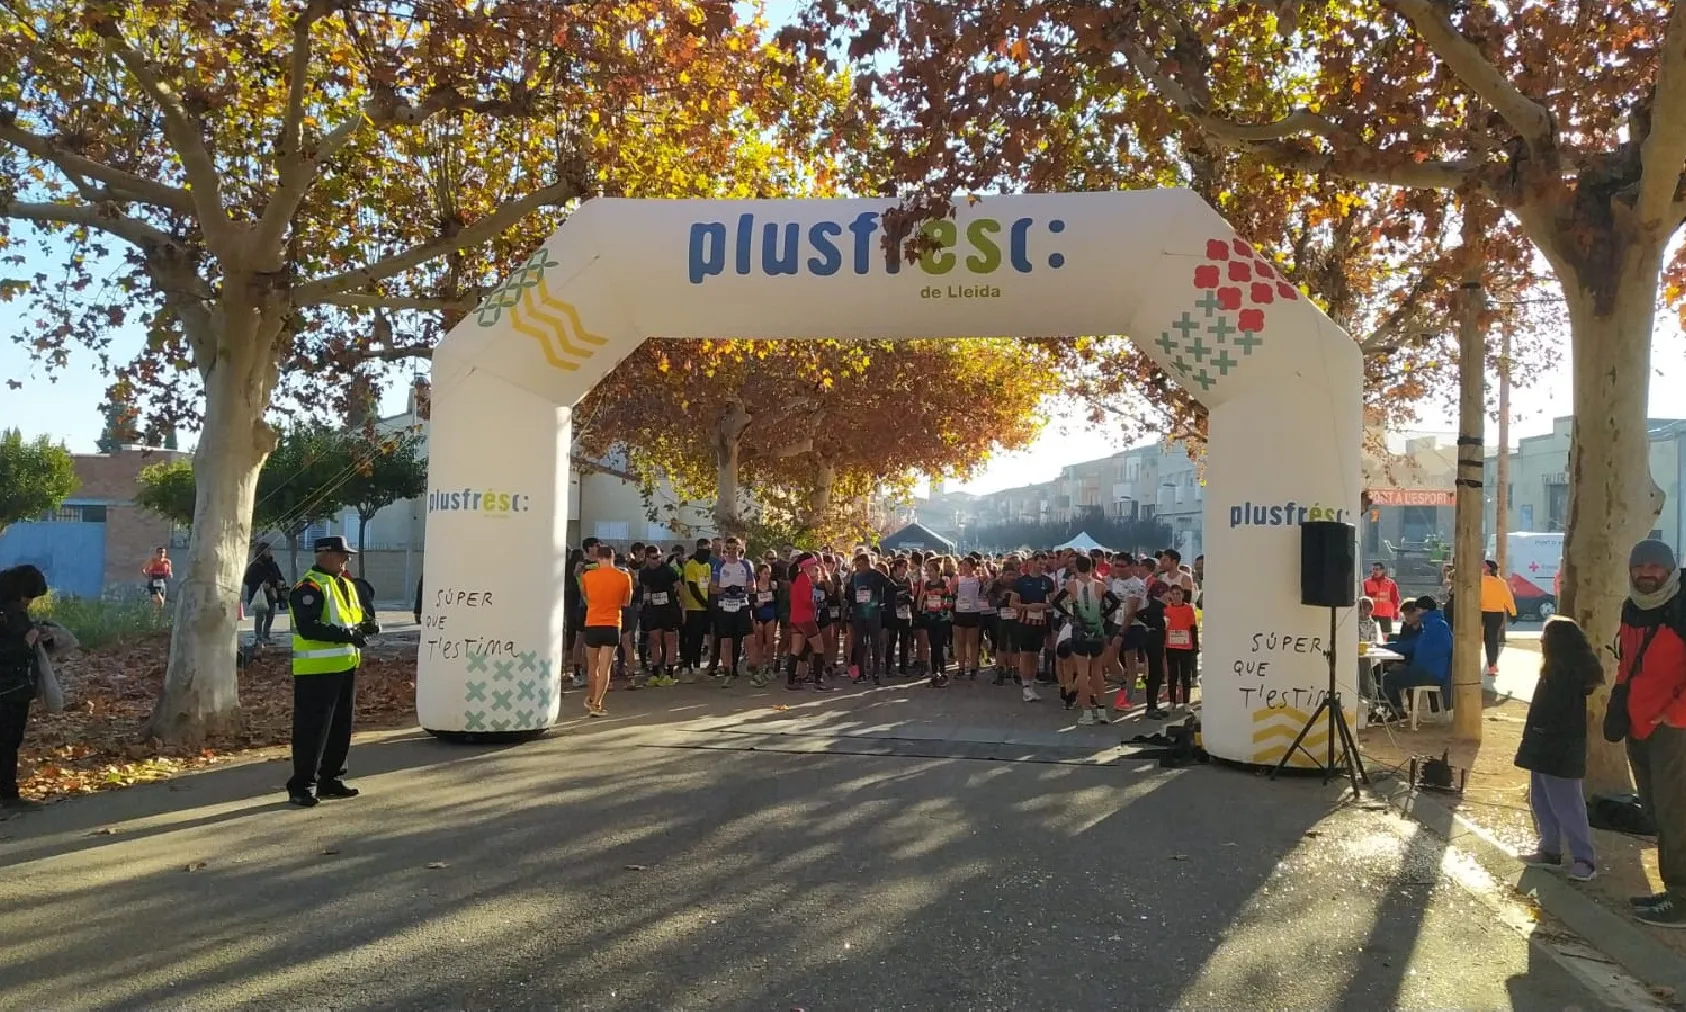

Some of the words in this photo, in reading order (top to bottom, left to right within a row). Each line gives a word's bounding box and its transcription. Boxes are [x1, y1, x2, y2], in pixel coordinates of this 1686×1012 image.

[920, 284, 942, 299] de
[948, 284, 1001, 299] Lleida
[426, 615, 447, 630] QUE
[1233, 660, 1270, 677] QUE
